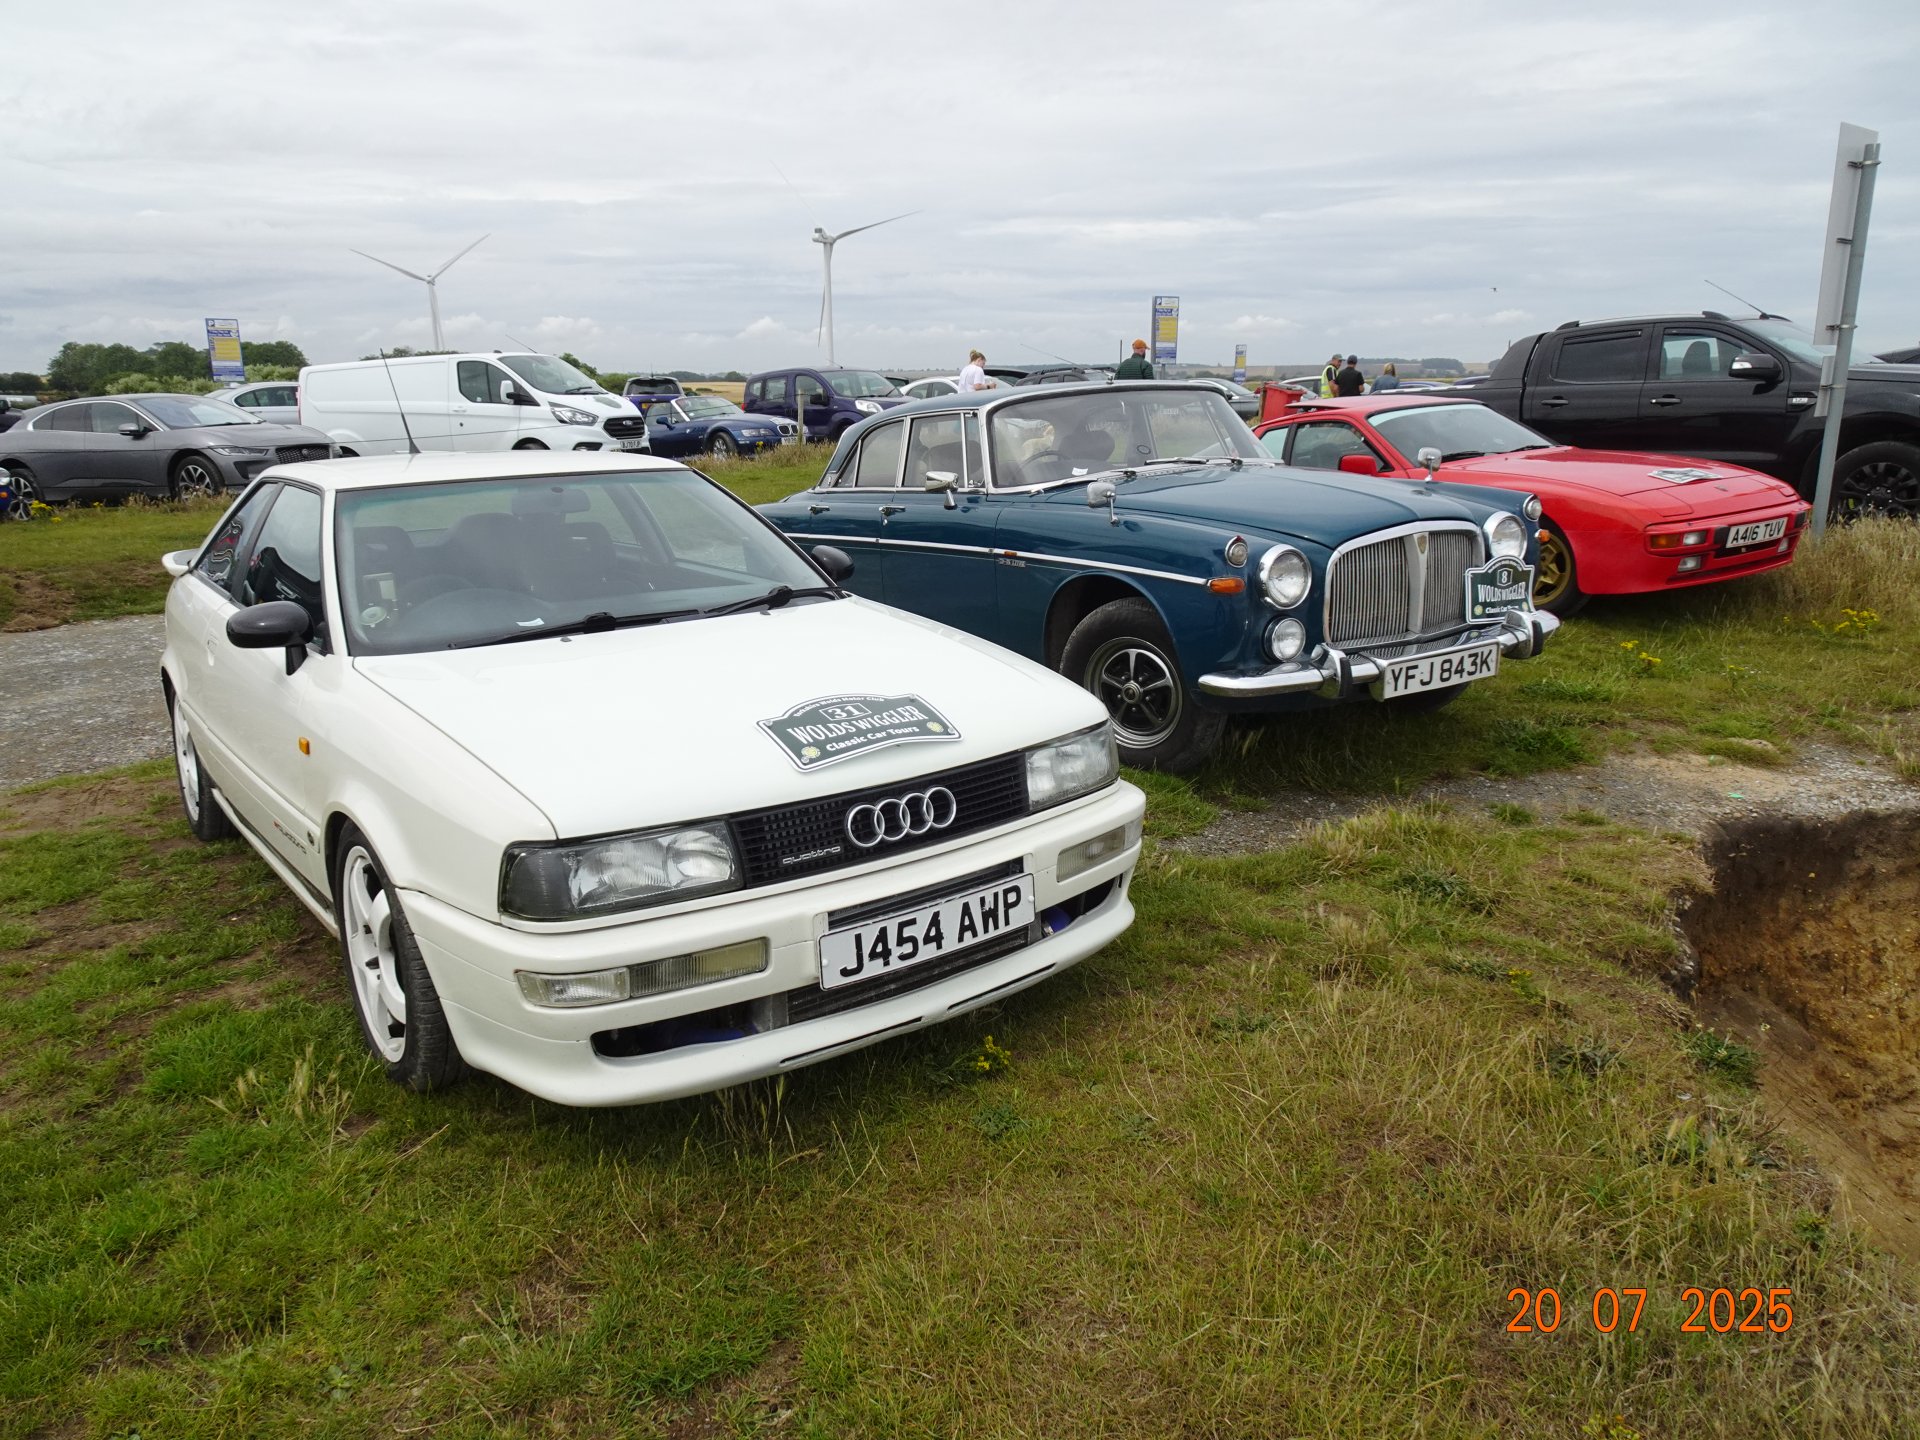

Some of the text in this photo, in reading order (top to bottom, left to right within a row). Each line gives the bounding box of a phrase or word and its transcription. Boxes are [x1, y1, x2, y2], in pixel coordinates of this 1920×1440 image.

[1731, 520, 1785, 544] A416 TUV
[1501, 570, 1508, 584] 8
[1477, 581, 1526, 603] WOLDS WIGGLER
[1391, 649, 1493, 692] YFJ 843K
[827, 705, 865, 719] 31
[786, 705, 929, 745] WOLDS WIGGLER
[825, 726, 920, 751] Classic Car Tours
[782, 846, 841, 865] quattro
[839, 885, 1022, 978] J454 AWP
